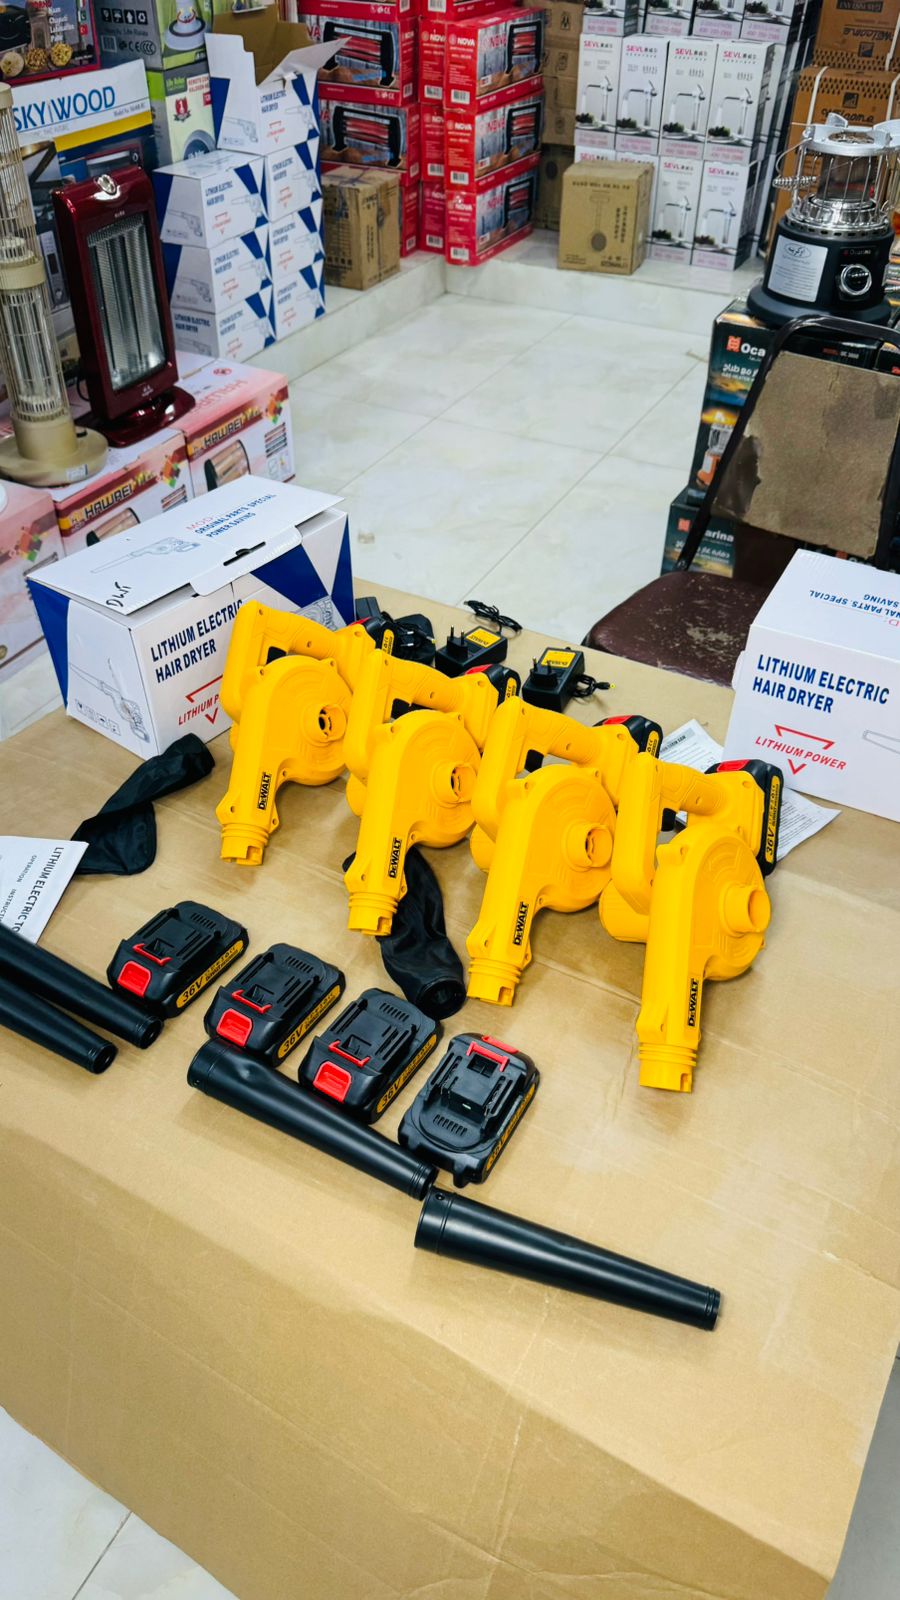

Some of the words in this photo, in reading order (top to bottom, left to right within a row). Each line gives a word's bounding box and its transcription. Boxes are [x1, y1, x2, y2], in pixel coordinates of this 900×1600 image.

[457, 37, 476, 47] NOVA
[809, 590, 849, 605] SPECIAL
[151, 625, 196, 663] LITHIUM
[155, 658, 186, 684] HAIR
[184, 638, 217, 669] DRYER
[752, 676, 786, 701] HAIR
[786, 686, 834, 713] DRYER
[757, 654, 817, 684] LITHIUM
[818, 671, 890, 705] ELECTRIC
[178, 696, 213, 726] LITHIUM
[755, 736, 804, 758] LITHIUM
[804, 750, 848, 770] POWER
[41, 846, 65, 880] LITHIUM
[18, 879, 46, 921] ELECTRIC
[182, 974, 206, 1003] 36V
[283, 1021, 307, 1053] 36V
